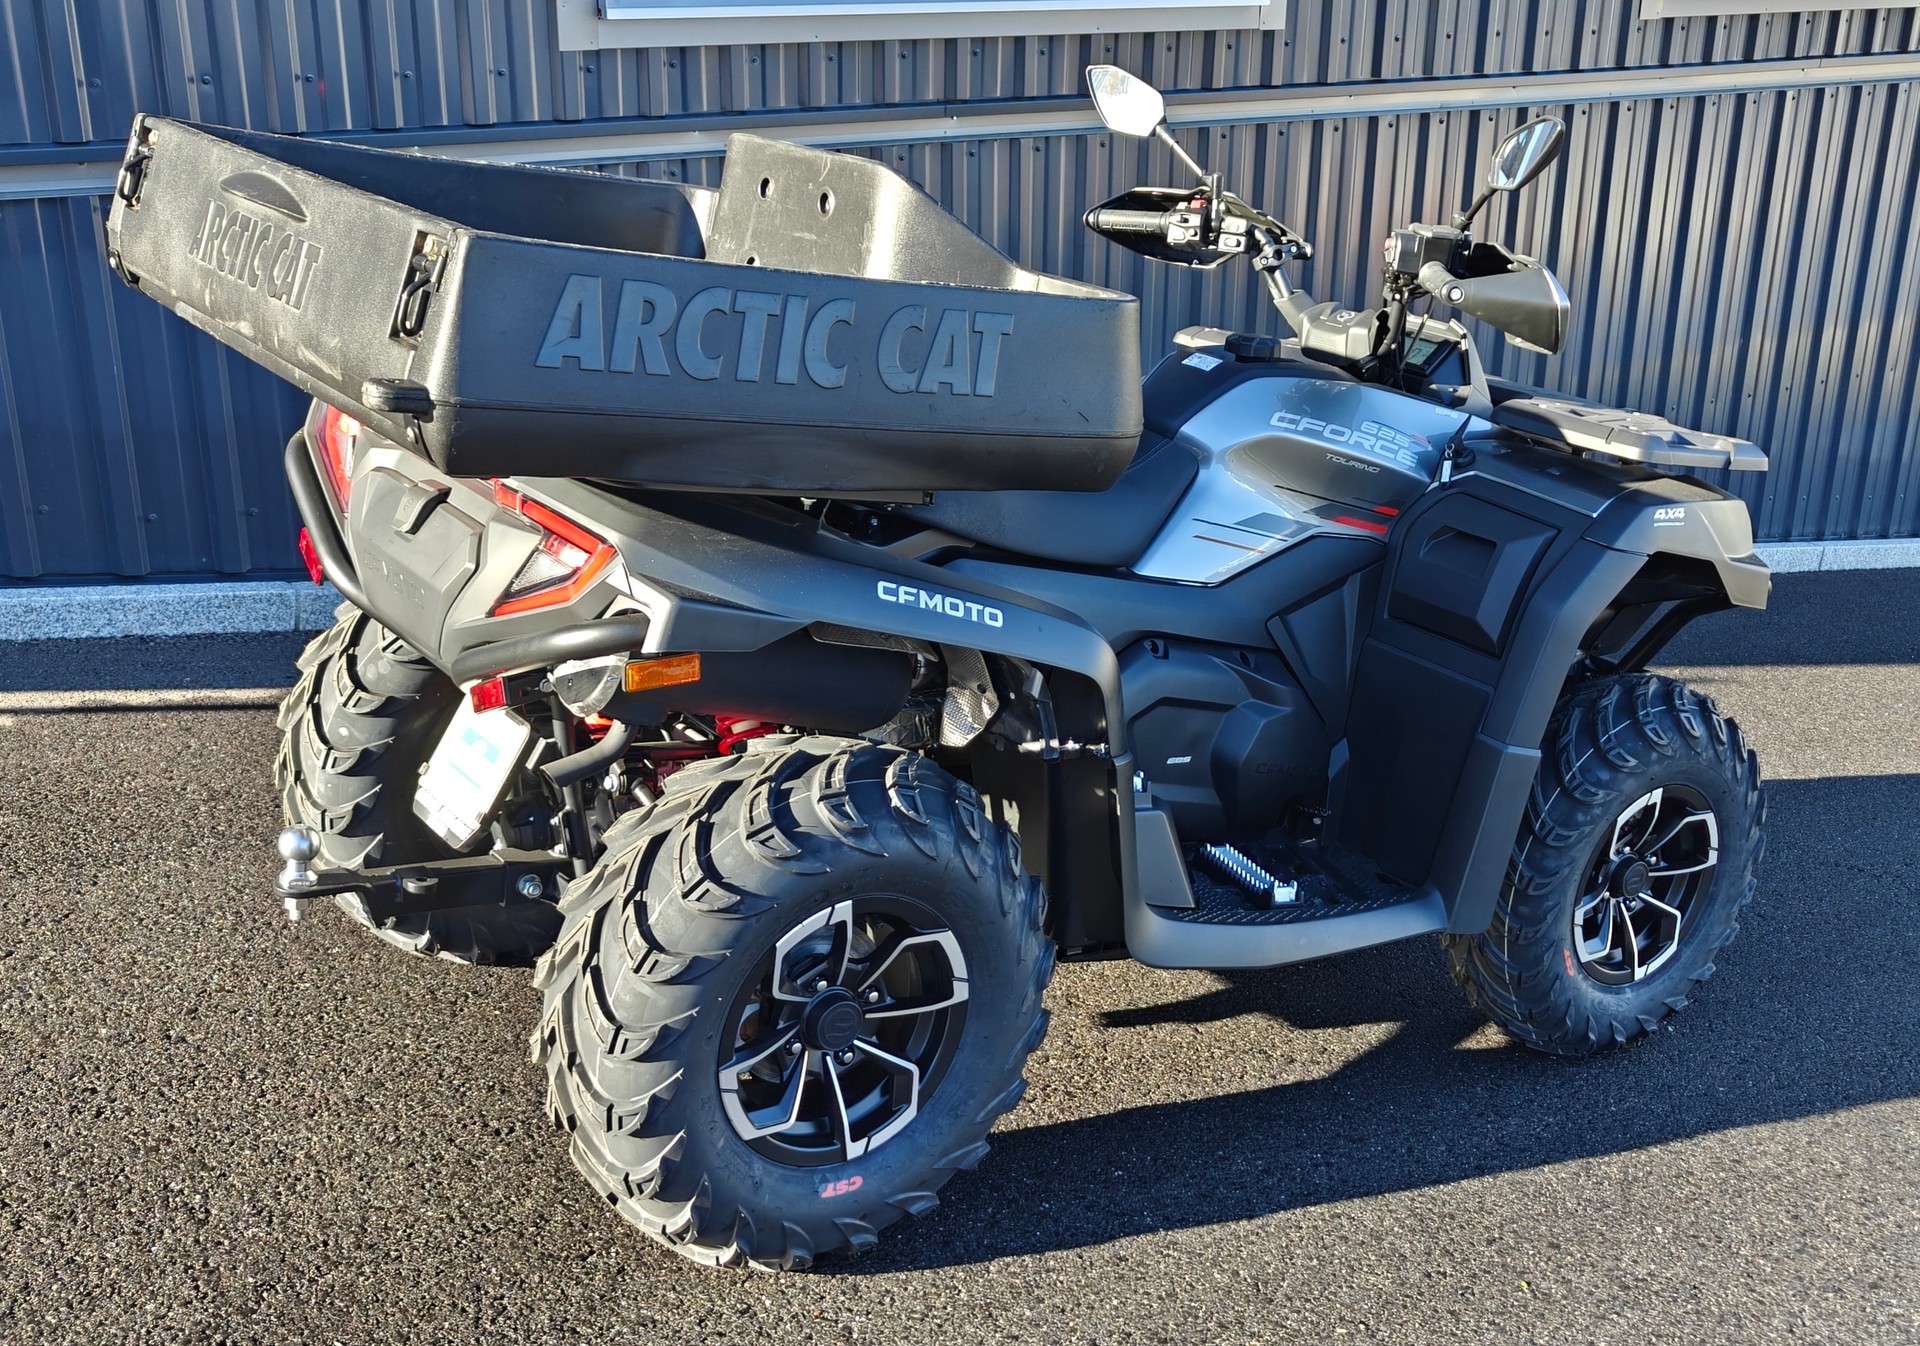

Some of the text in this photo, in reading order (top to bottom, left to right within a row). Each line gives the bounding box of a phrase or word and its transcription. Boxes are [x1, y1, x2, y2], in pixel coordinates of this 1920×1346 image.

[188, 199, 324, 311] ARCTIC CAT
[534, 273, 1015, 398] ARCTIC CAT
[1269, 411, 1419, 468] CFORCE
[1325, 453, 1381, 474] TOURING
[877, 580, 1004, 628] CFMOTO
[821, 1175, 864, 1198] CST
